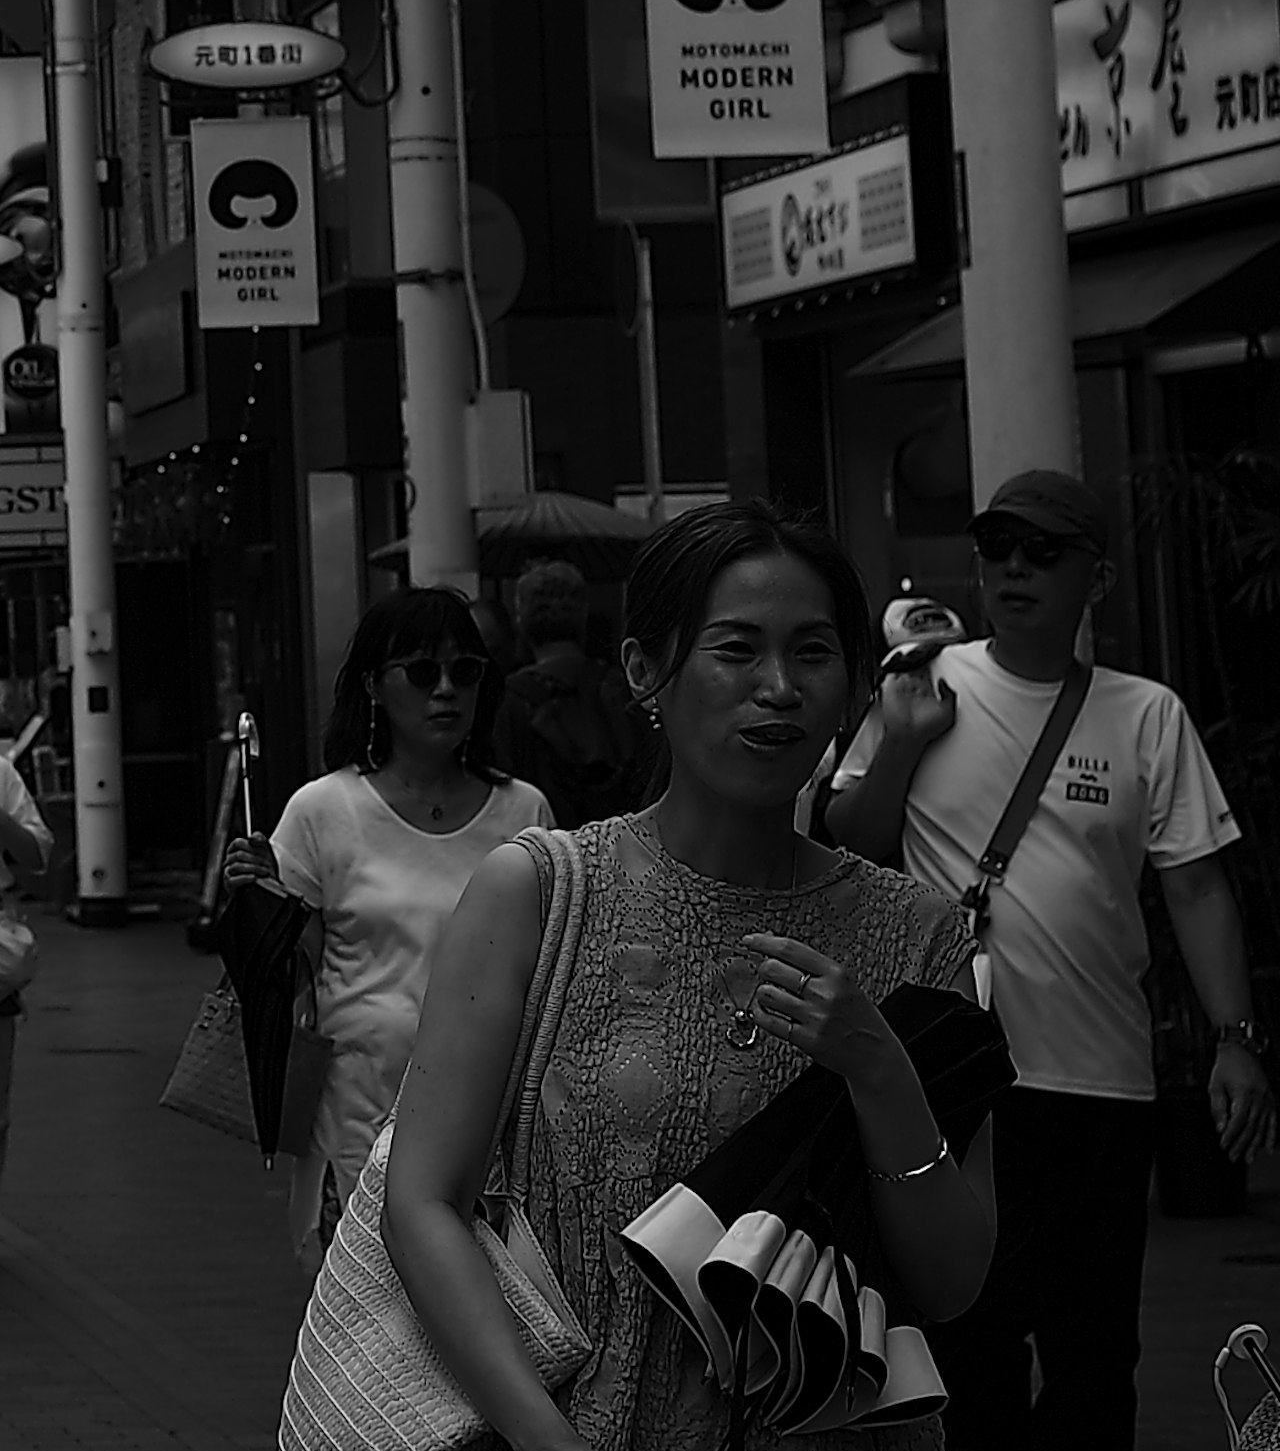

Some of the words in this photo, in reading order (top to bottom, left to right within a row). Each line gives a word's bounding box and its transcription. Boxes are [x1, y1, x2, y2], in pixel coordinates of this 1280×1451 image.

[194, 43, 302, 68] 元町1番街
[681, 43, 790, 58] MOTOMACHI
[680, 66, 793, 89] MODERN
[709, 99, 771, 120] GIRL
[216, 265, 296, 282] MODERN
[237, 287, 280, 303] GIRL
